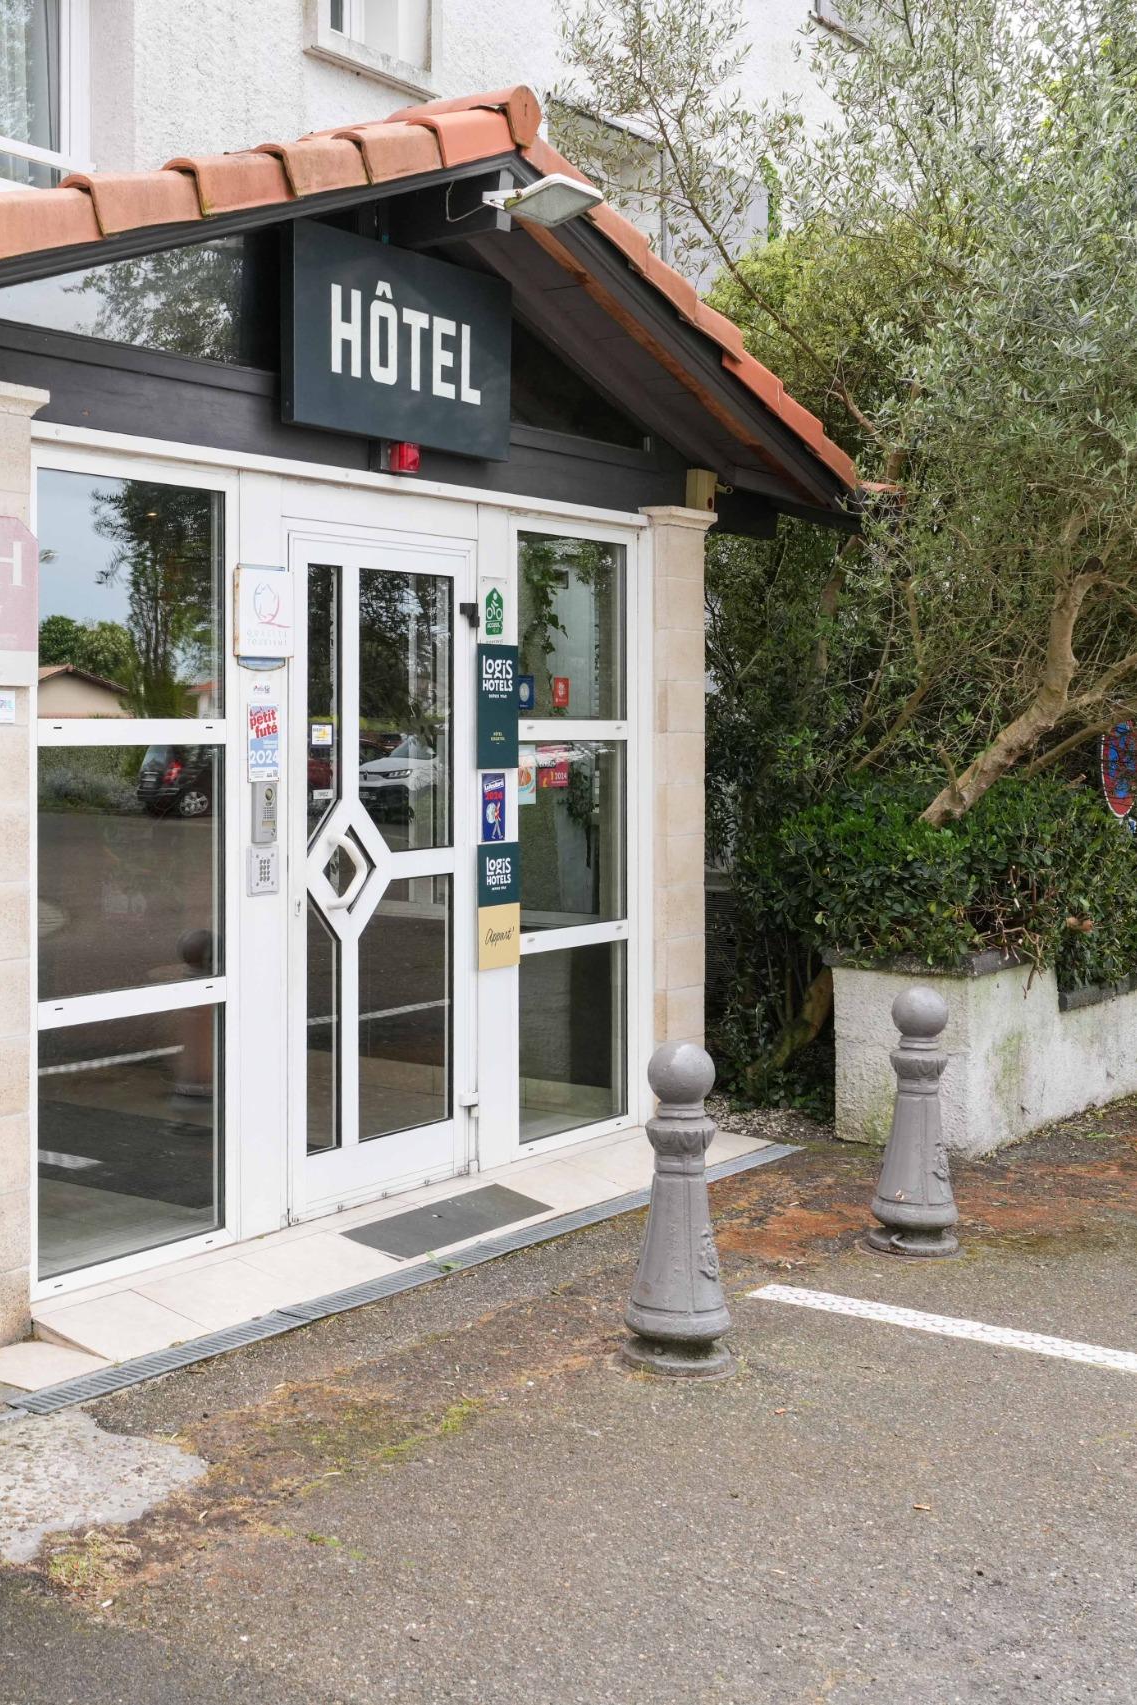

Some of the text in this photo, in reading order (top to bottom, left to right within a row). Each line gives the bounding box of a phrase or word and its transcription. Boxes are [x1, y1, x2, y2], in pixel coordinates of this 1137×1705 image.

[330, 280, 482, 406] HÔTEL
[482, 679, 513, 692] HOTELS
[250, 709, 277, 730] petit
[255, 721, 278, 739] futé
[486, 874, 511, 886] HOTELS
